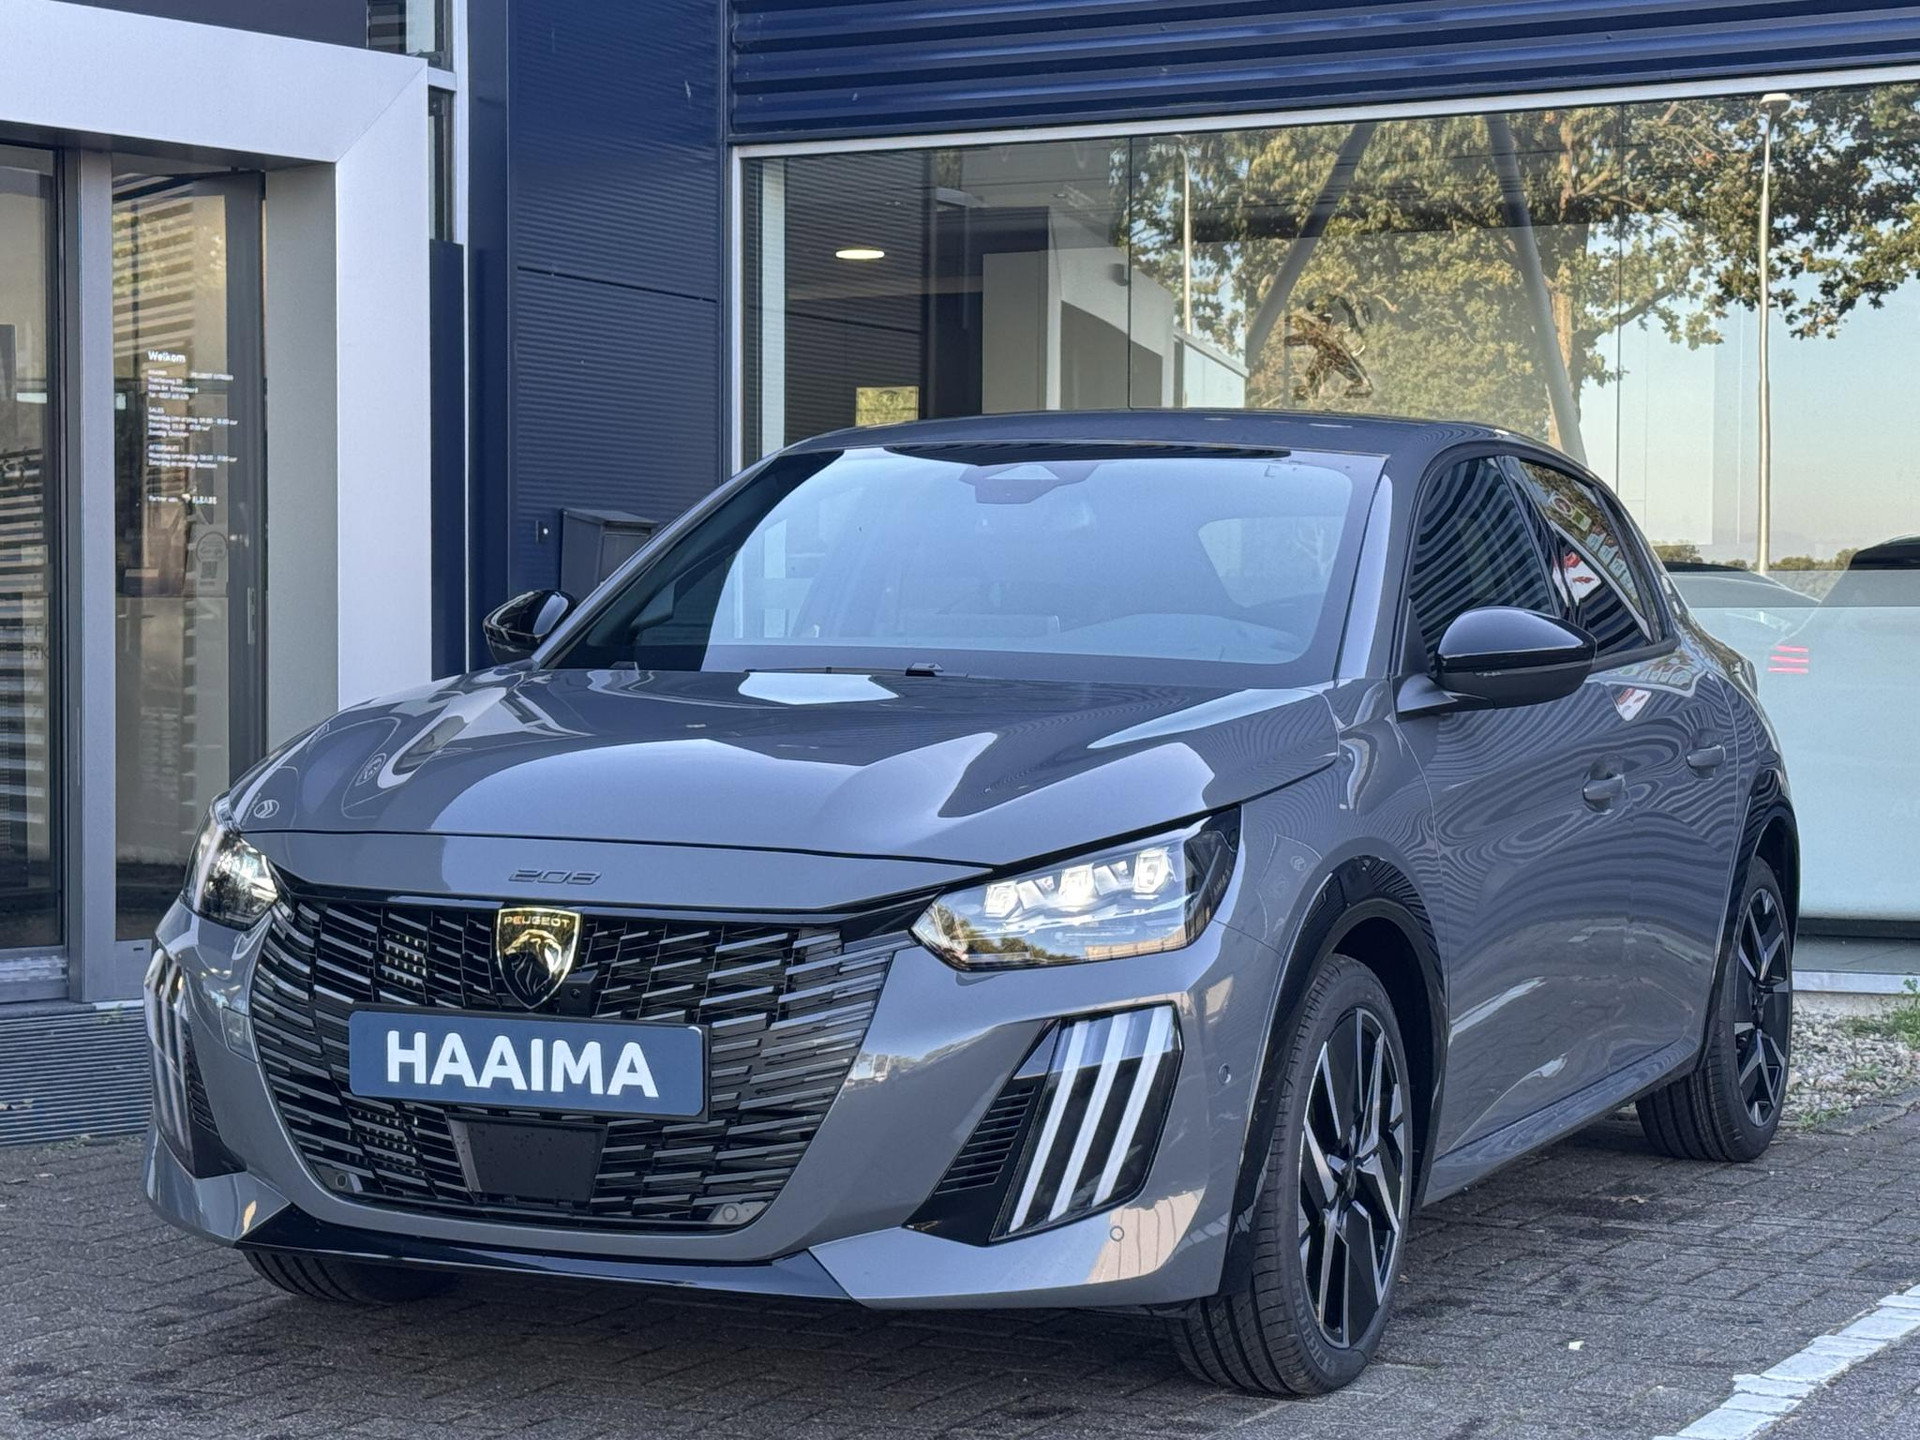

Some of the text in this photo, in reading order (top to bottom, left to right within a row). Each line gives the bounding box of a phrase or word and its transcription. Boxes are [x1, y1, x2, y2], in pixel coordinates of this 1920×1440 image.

[148, 351, 186, 363] Welkom
[508, 867, 603, 886] 208
[503, 914, 571, 927] PEUGEOT
[386, 1029, 660, 1098] HAAIMA
